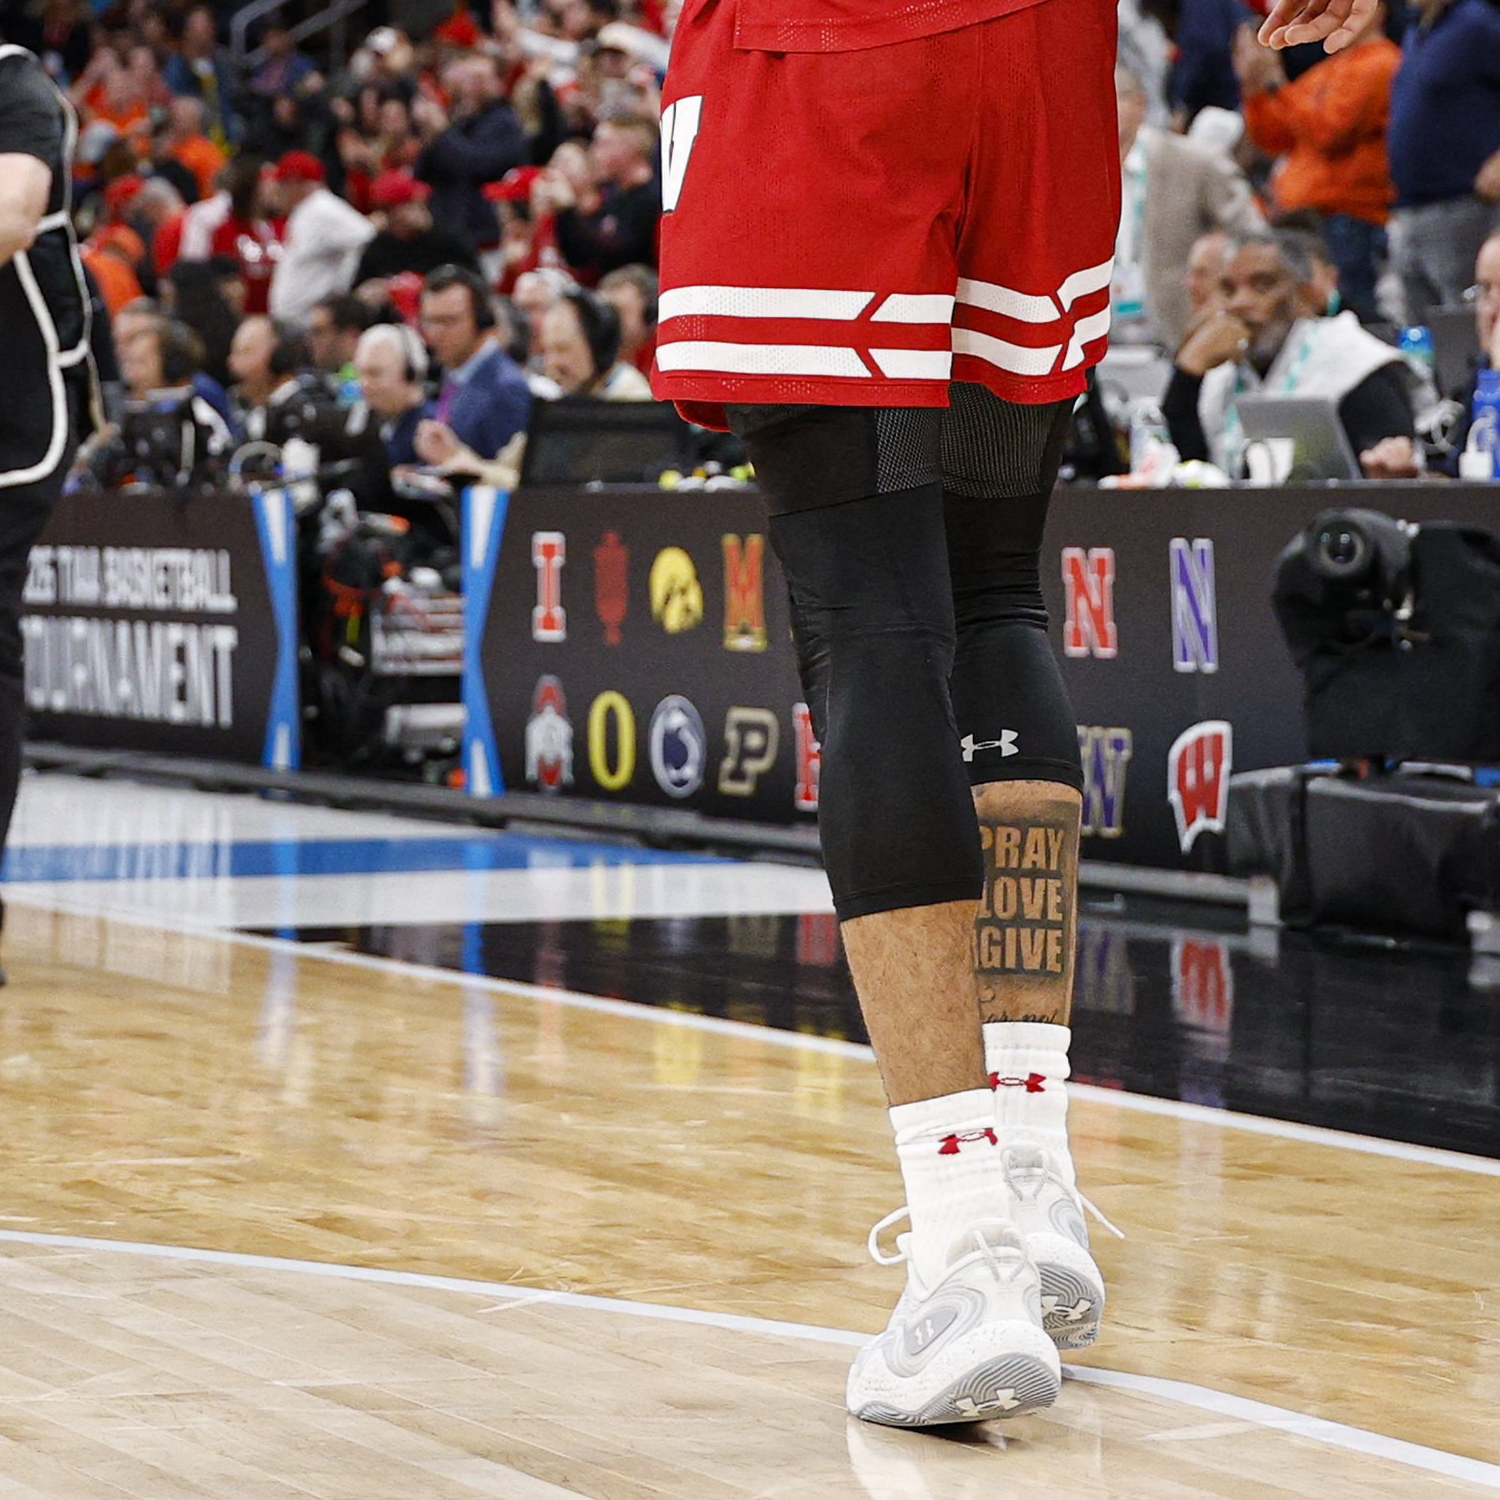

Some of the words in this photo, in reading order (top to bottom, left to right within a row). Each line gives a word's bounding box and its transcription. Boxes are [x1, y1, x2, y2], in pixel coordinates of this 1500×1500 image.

[102, 545, 238, 614] BASKETBALL
[1061, 547, 1117, 659] N
[1170, 537, 1219, 674] N
[20, 614, 238, 729] OURNAMENT
[717, 706, 780, 797] P
[978, 876, 1063, 922] LOVE
[980, 926, 1063, 973] GIVE
